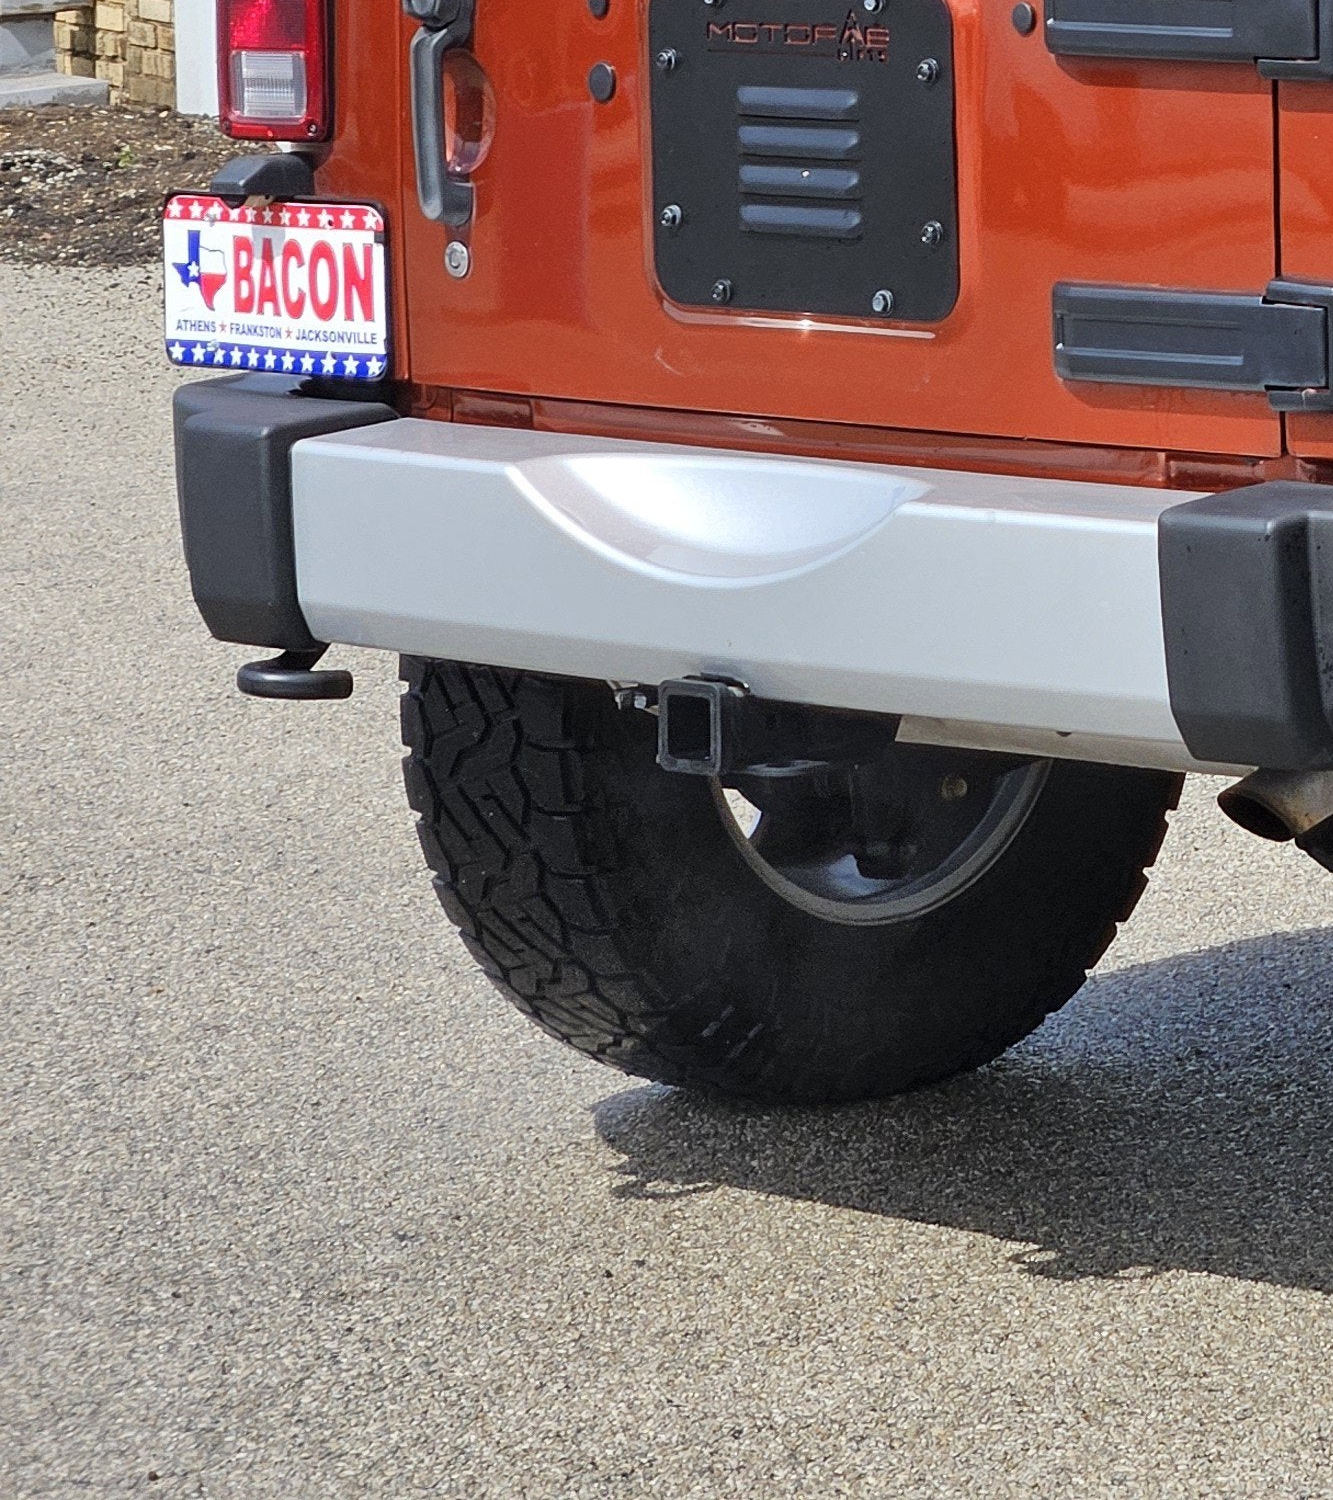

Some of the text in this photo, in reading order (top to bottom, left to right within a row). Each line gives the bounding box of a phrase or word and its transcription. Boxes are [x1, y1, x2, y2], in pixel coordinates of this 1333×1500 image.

[232, 234, 376, 323] BACON
[175, 319, 378, 345] ATHENS FRANKSTON JACKSONVILLE
